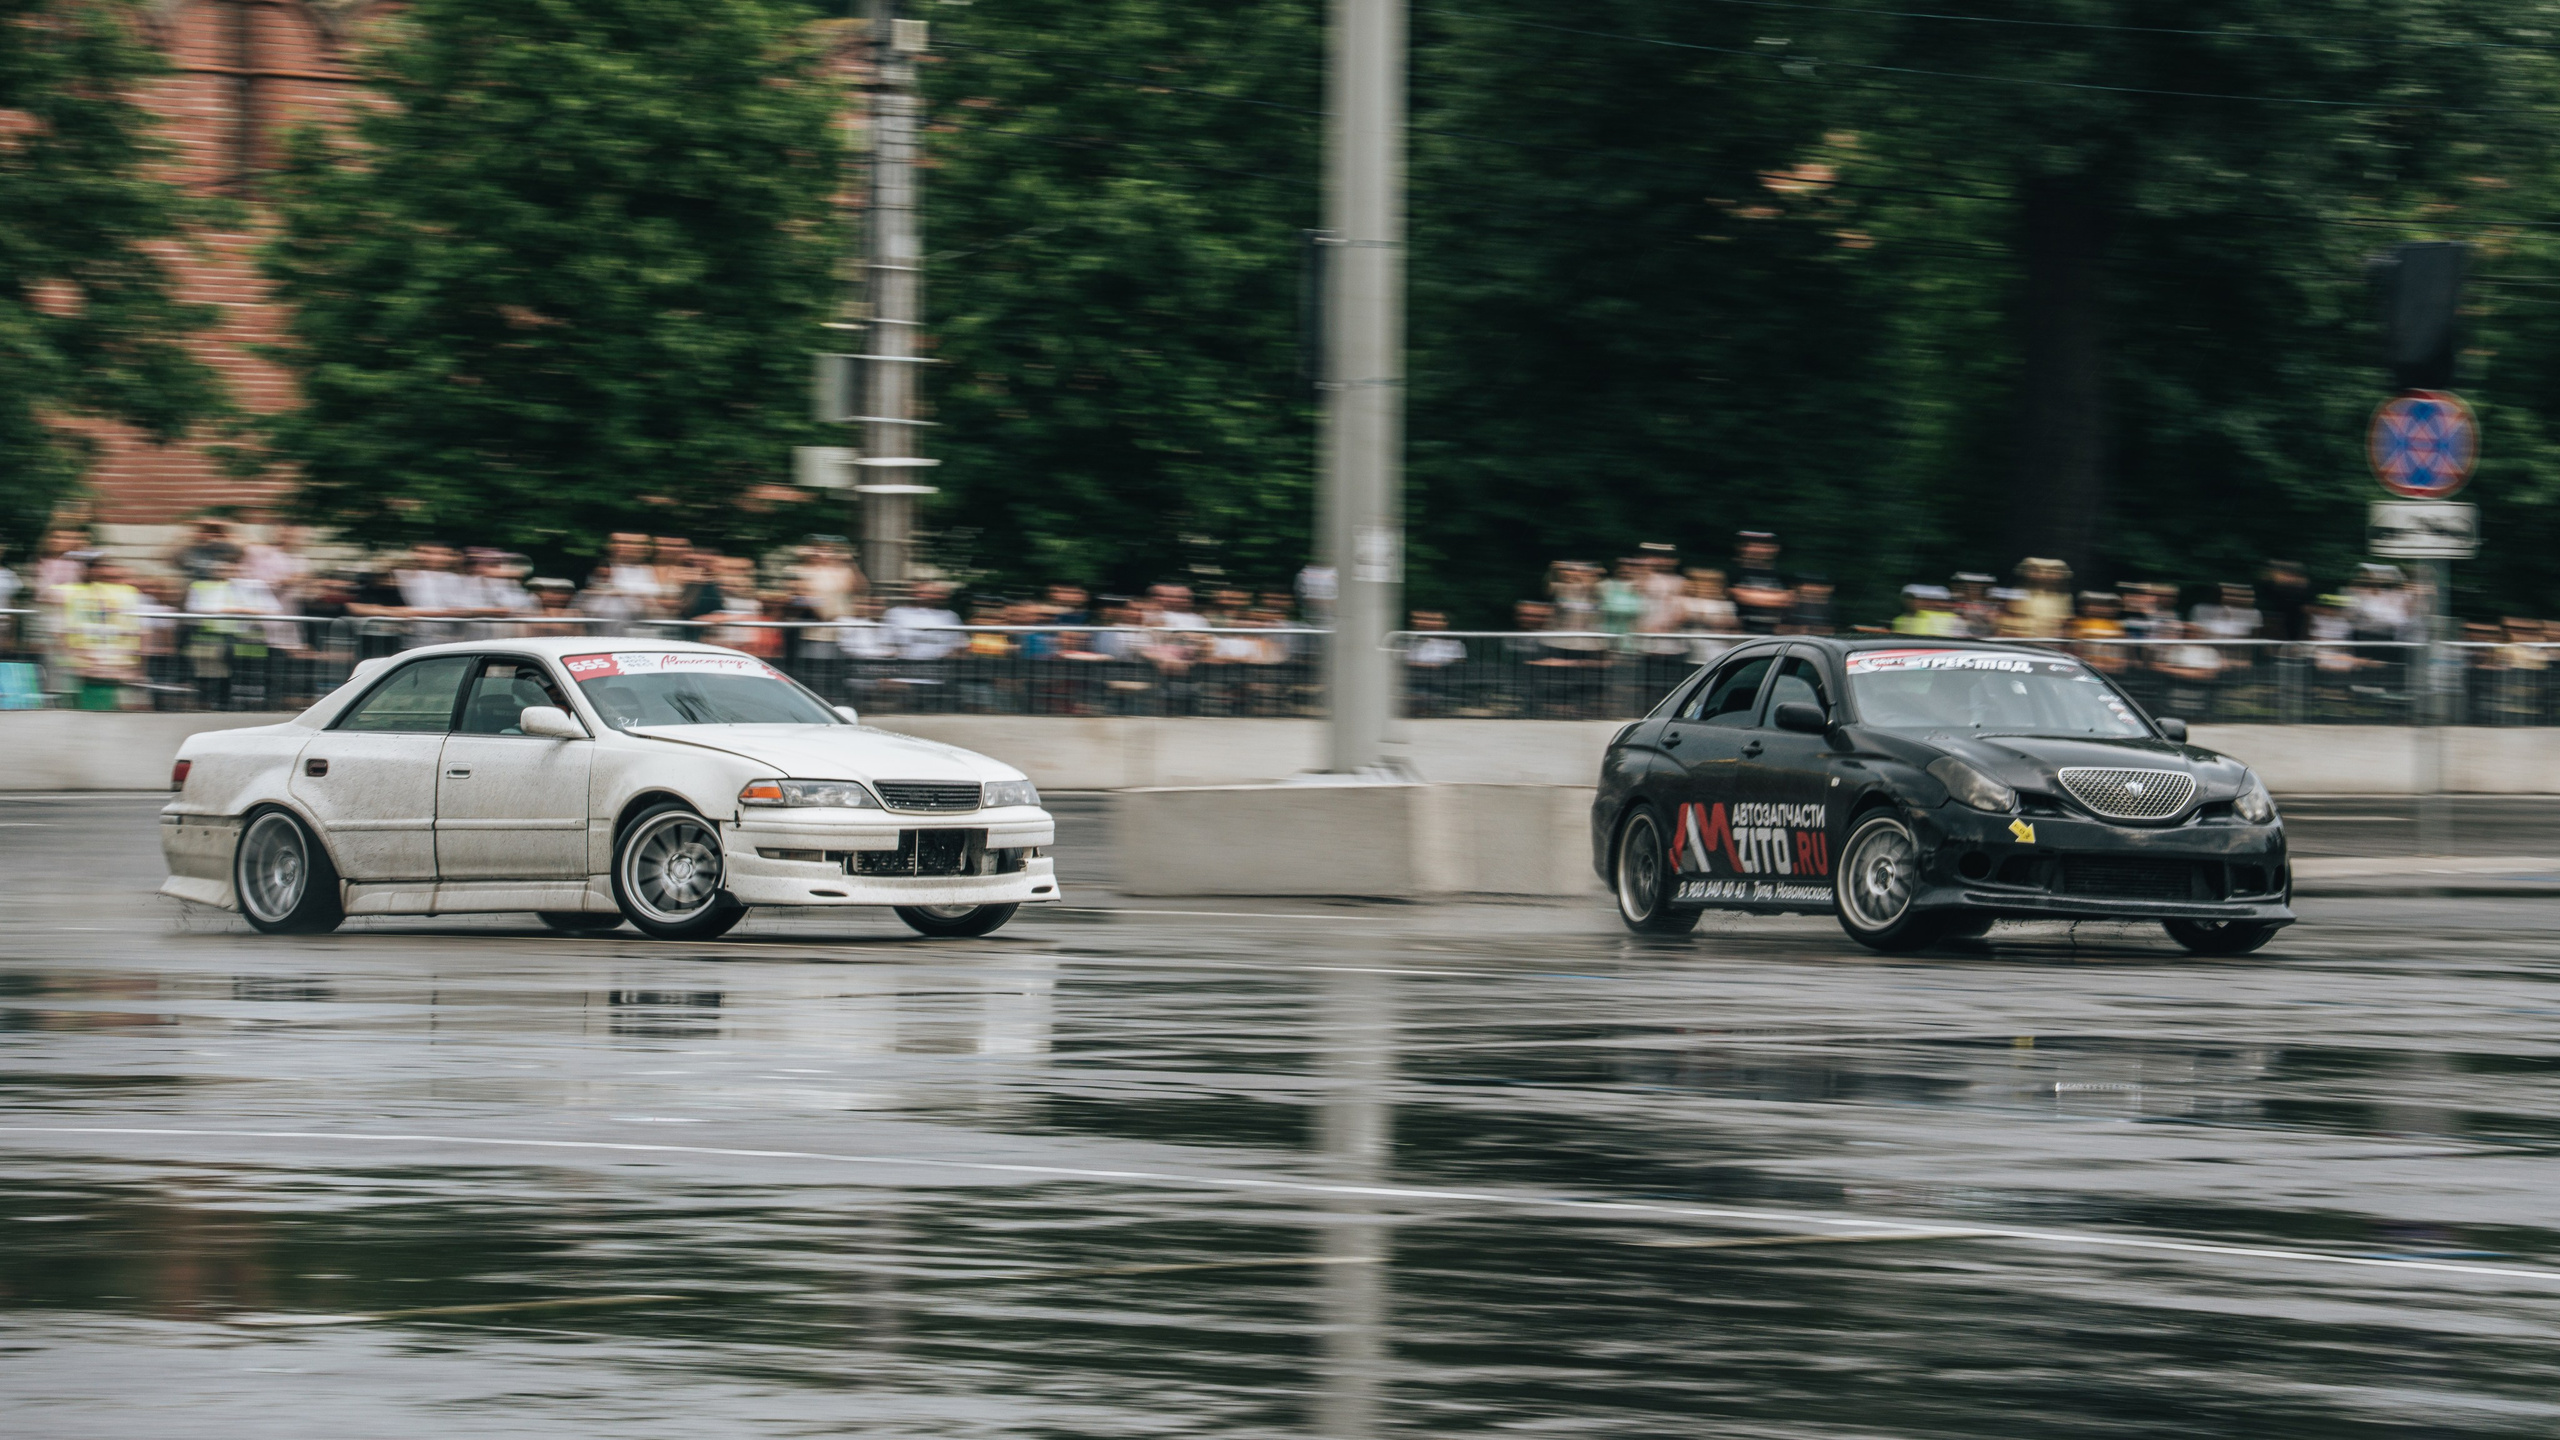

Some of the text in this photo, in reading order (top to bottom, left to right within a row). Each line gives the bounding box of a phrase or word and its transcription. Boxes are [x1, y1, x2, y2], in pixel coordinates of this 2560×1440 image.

[567, 658, 611, 672] 655
[1732, 803, 1826, 828] АВТОЗАПЧАСТИ
[1678, 881, 1687, 898] 8
[1688, 881, 1706, 898] 903
[1722, 881, 1735, 899] 40
[1734, 881, 1747, 899] 41
[1774, 881, 1833, 901] Новомосковс
